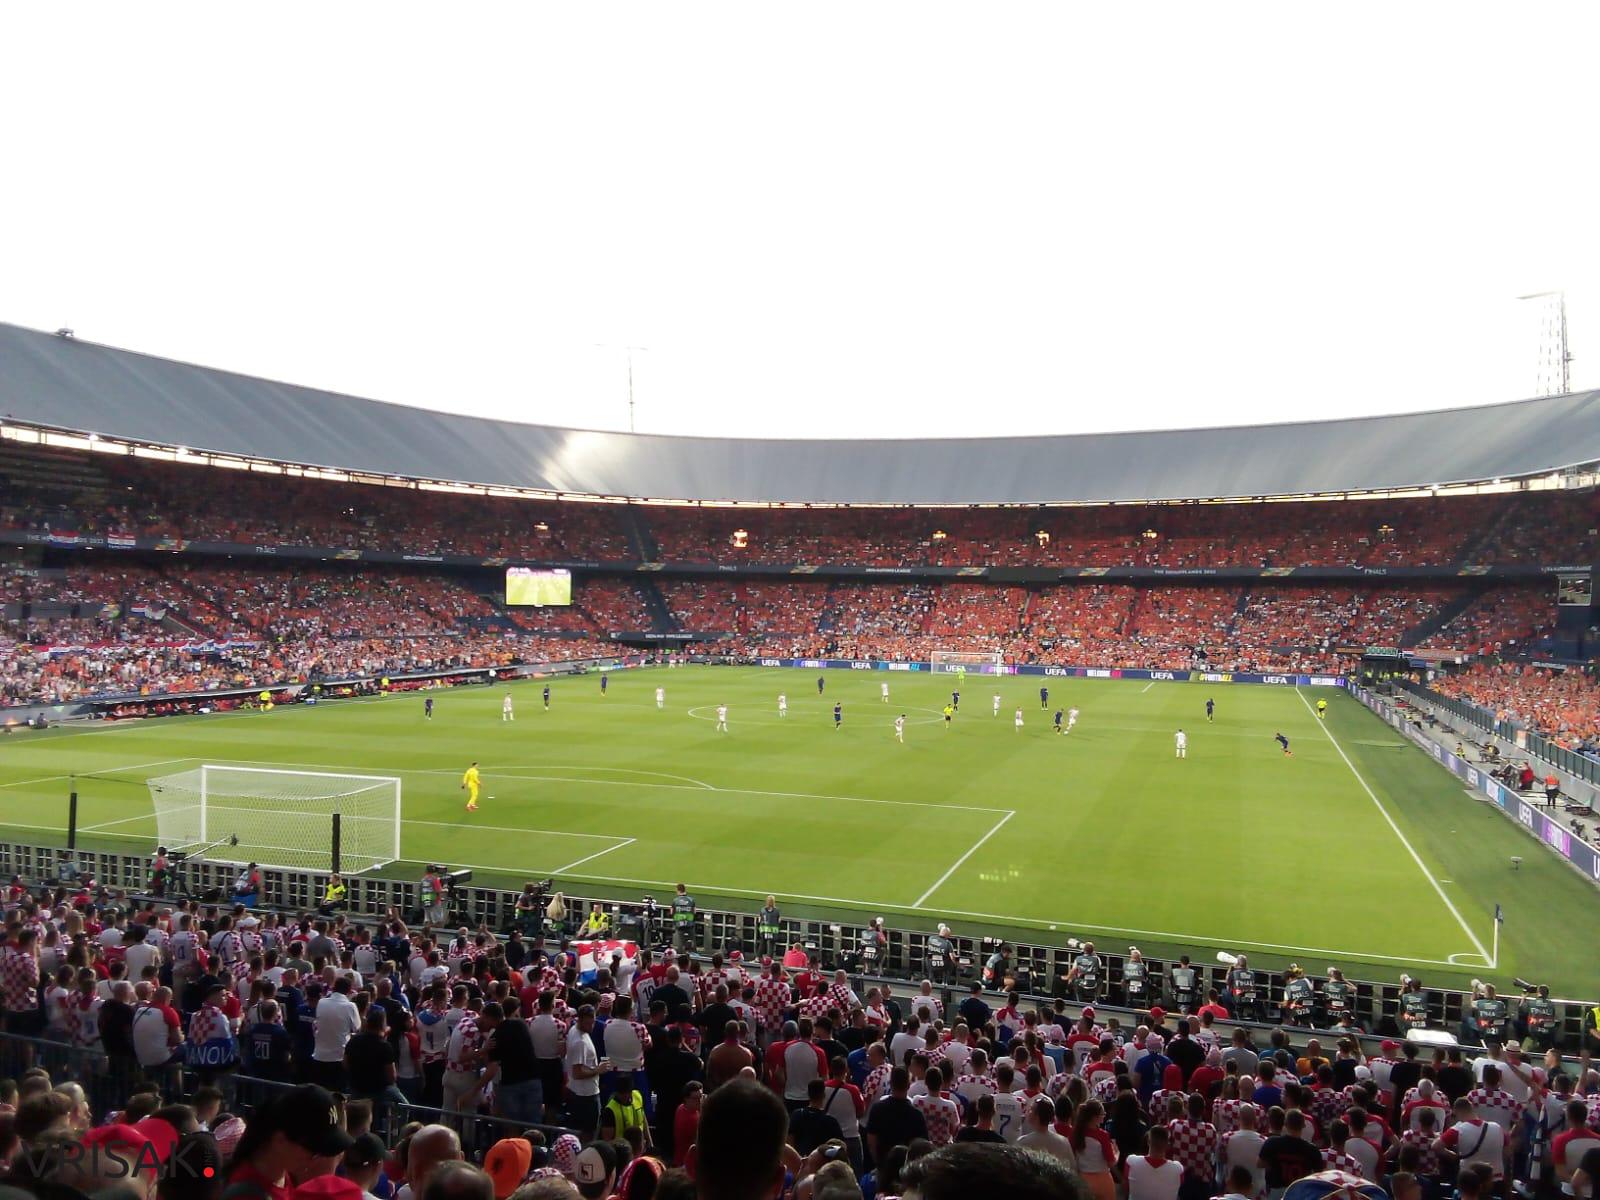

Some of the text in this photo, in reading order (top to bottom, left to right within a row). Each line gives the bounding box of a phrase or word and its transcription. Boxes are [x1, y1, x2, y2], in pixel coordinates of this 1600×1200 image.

[851, 662, 872, 670] UEFA
[945, 664, 967, 672] UEFA
[1044, 668, 1067, 676] UEFA
[1150, 671, 1174, 680] UEFA
[1262, 675, 1288, 684] UEFA
